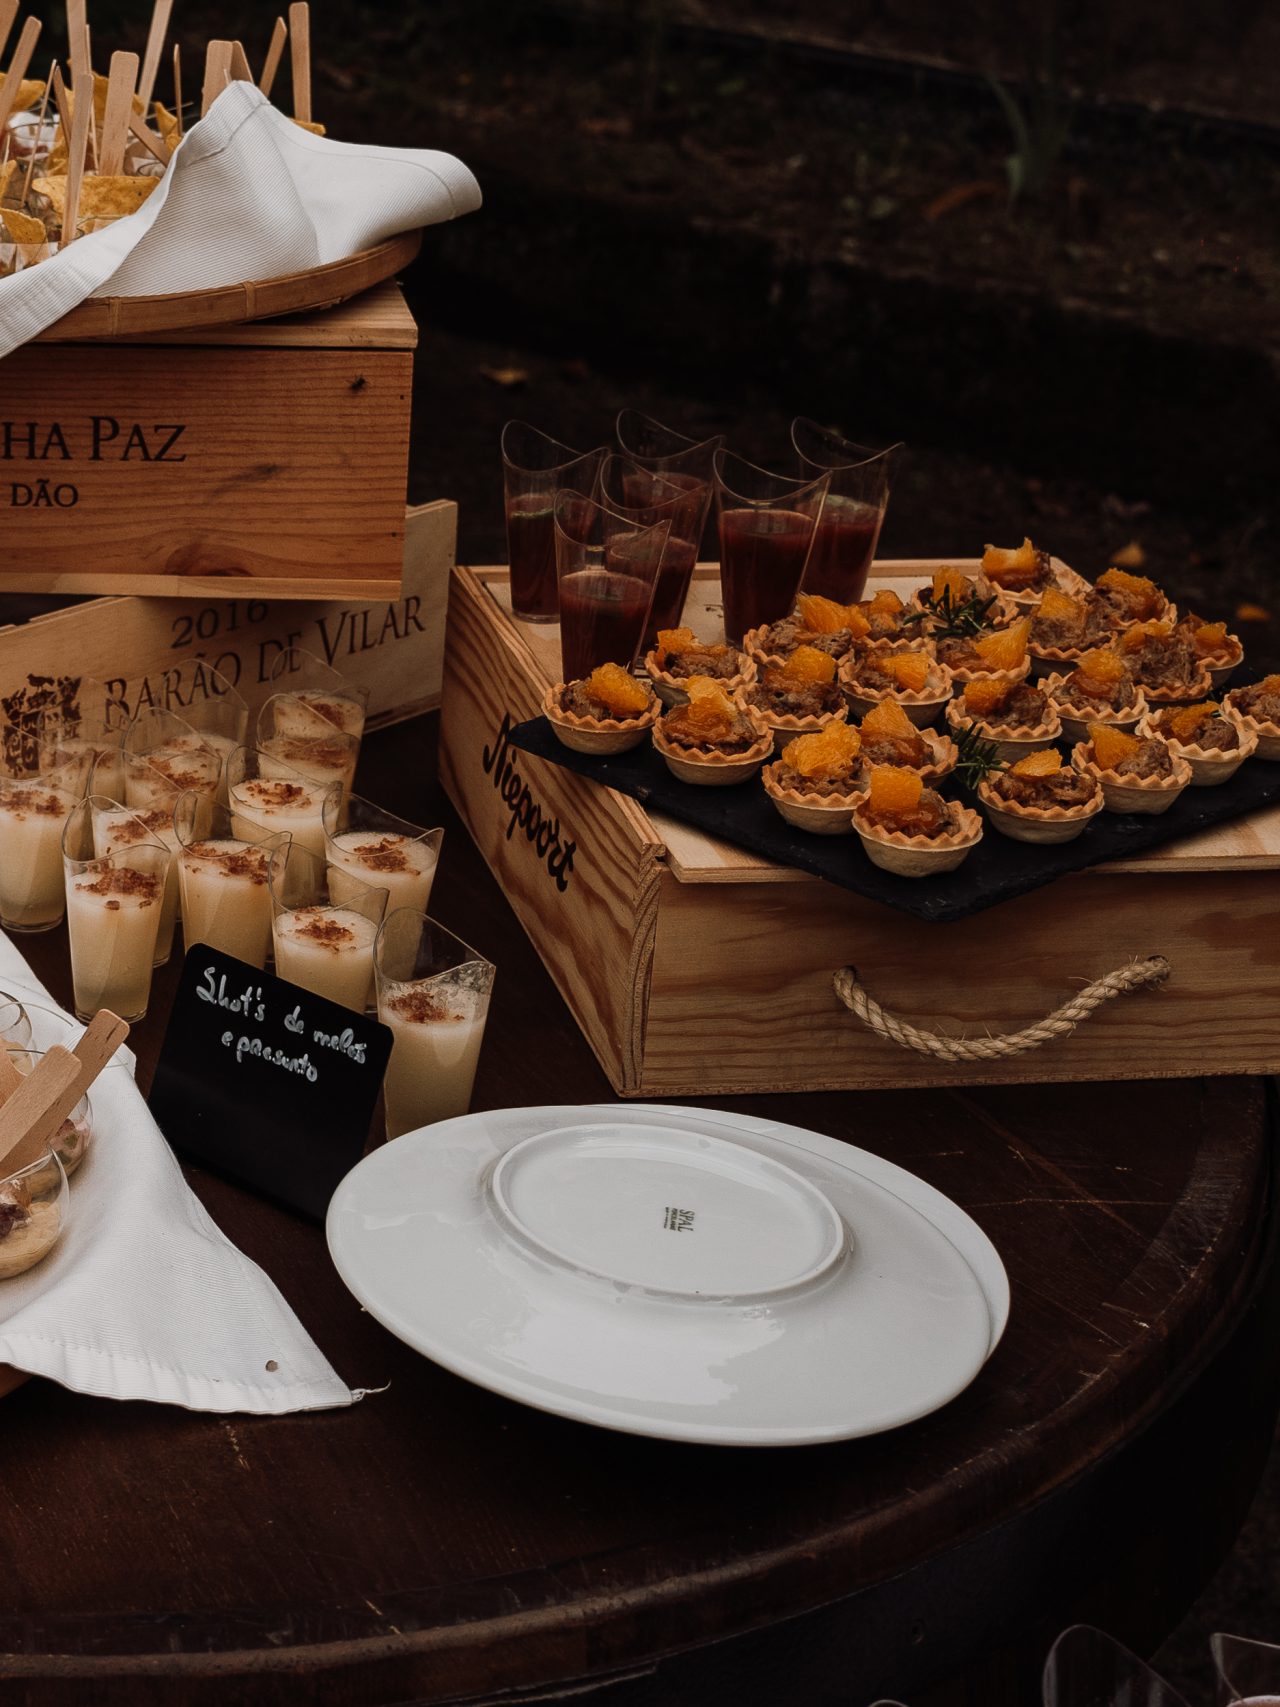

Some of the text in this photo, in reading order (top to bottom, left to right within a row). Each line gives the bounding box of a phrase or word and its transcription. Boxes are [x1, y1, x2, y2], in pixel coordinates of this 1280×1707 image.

[88, 415, 187, 463] PAZ
[10, 478, 79, 508] DÃO
[171, 599, 269, 649] 2016
[104, 595, 426, 735] BARÃO DE VILAR
[221, 1031, 234, 1047] e
[677, 1209, 696, 1232] SPAL
